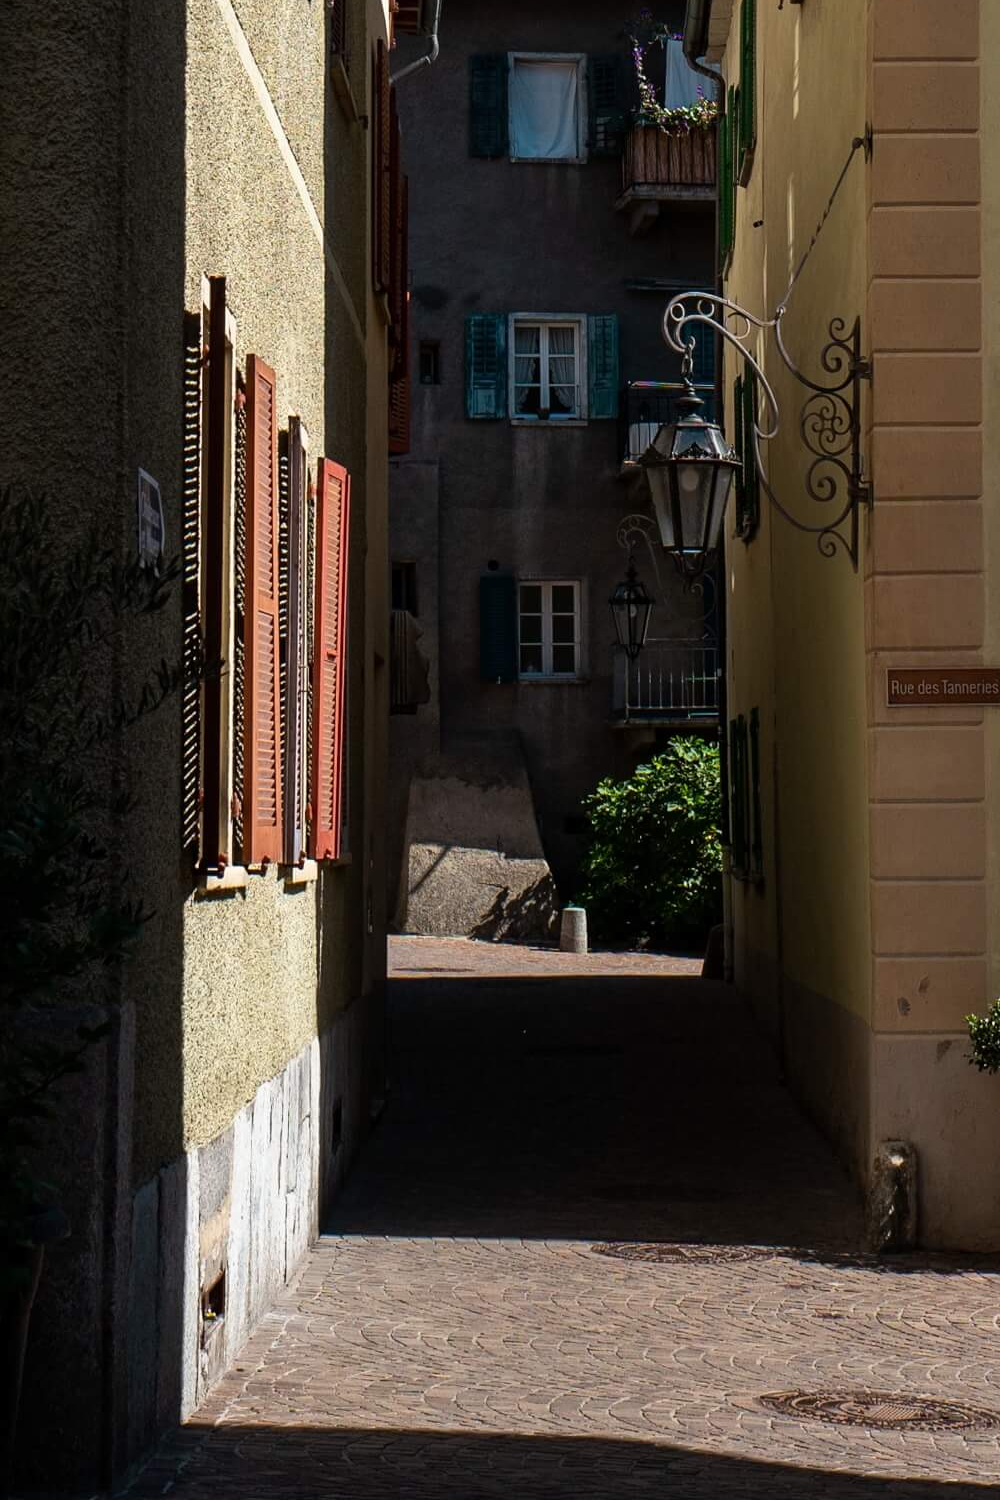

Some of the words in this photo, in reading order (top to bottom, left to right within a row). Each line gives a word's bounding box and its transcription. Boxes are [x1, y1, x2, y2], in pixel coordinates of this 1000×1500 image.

[891, 680, 914, 694] Rue
[918, 679, 939, 694] des
[941, 679, 999, 694] Tanneries
